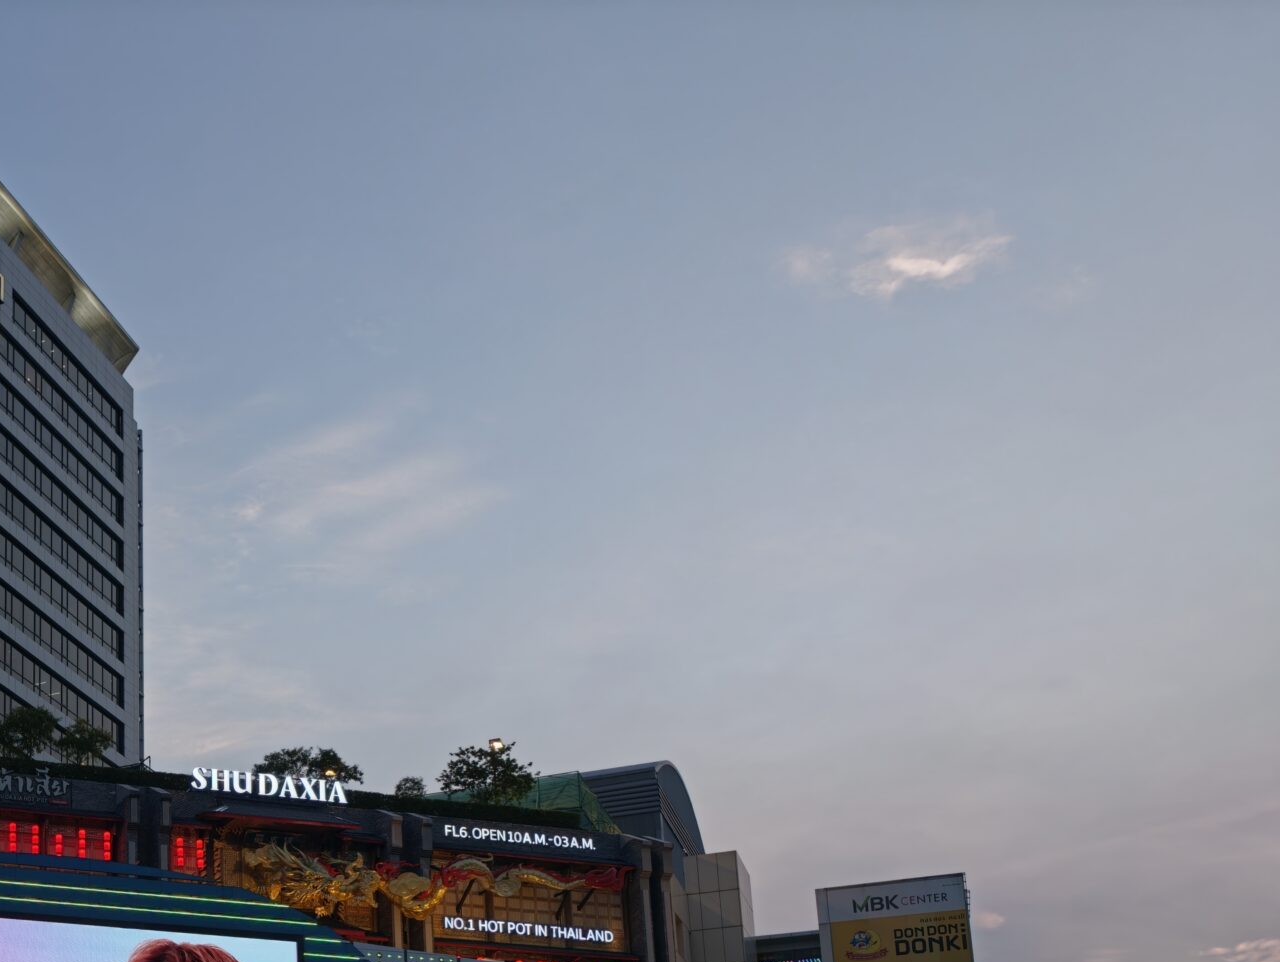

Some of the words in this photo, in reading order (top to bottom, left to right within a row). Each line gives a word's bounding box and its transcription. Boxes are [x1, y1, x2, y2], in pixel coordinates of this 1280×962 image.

[191, 766, 253, 795] SHU
[258, 772, 348, 804] DAXIA
[472, 827, 507, 842] OPEN
[570, 837, 596, 850] A.M.
[852, 894, 900, 914] MBK
[900, 893, 948, 906] CENTER
[444, 917, 475, 931] NO.1
[478, 920, 505, 933] HOT
[507, 922, 532, 934] POT
[534, 924, 548, 937] IN
[549, 926, 614, 943] THAILAND
[893, 926, 925, 939] DON
[894, 935, 968, 956] DONKI
